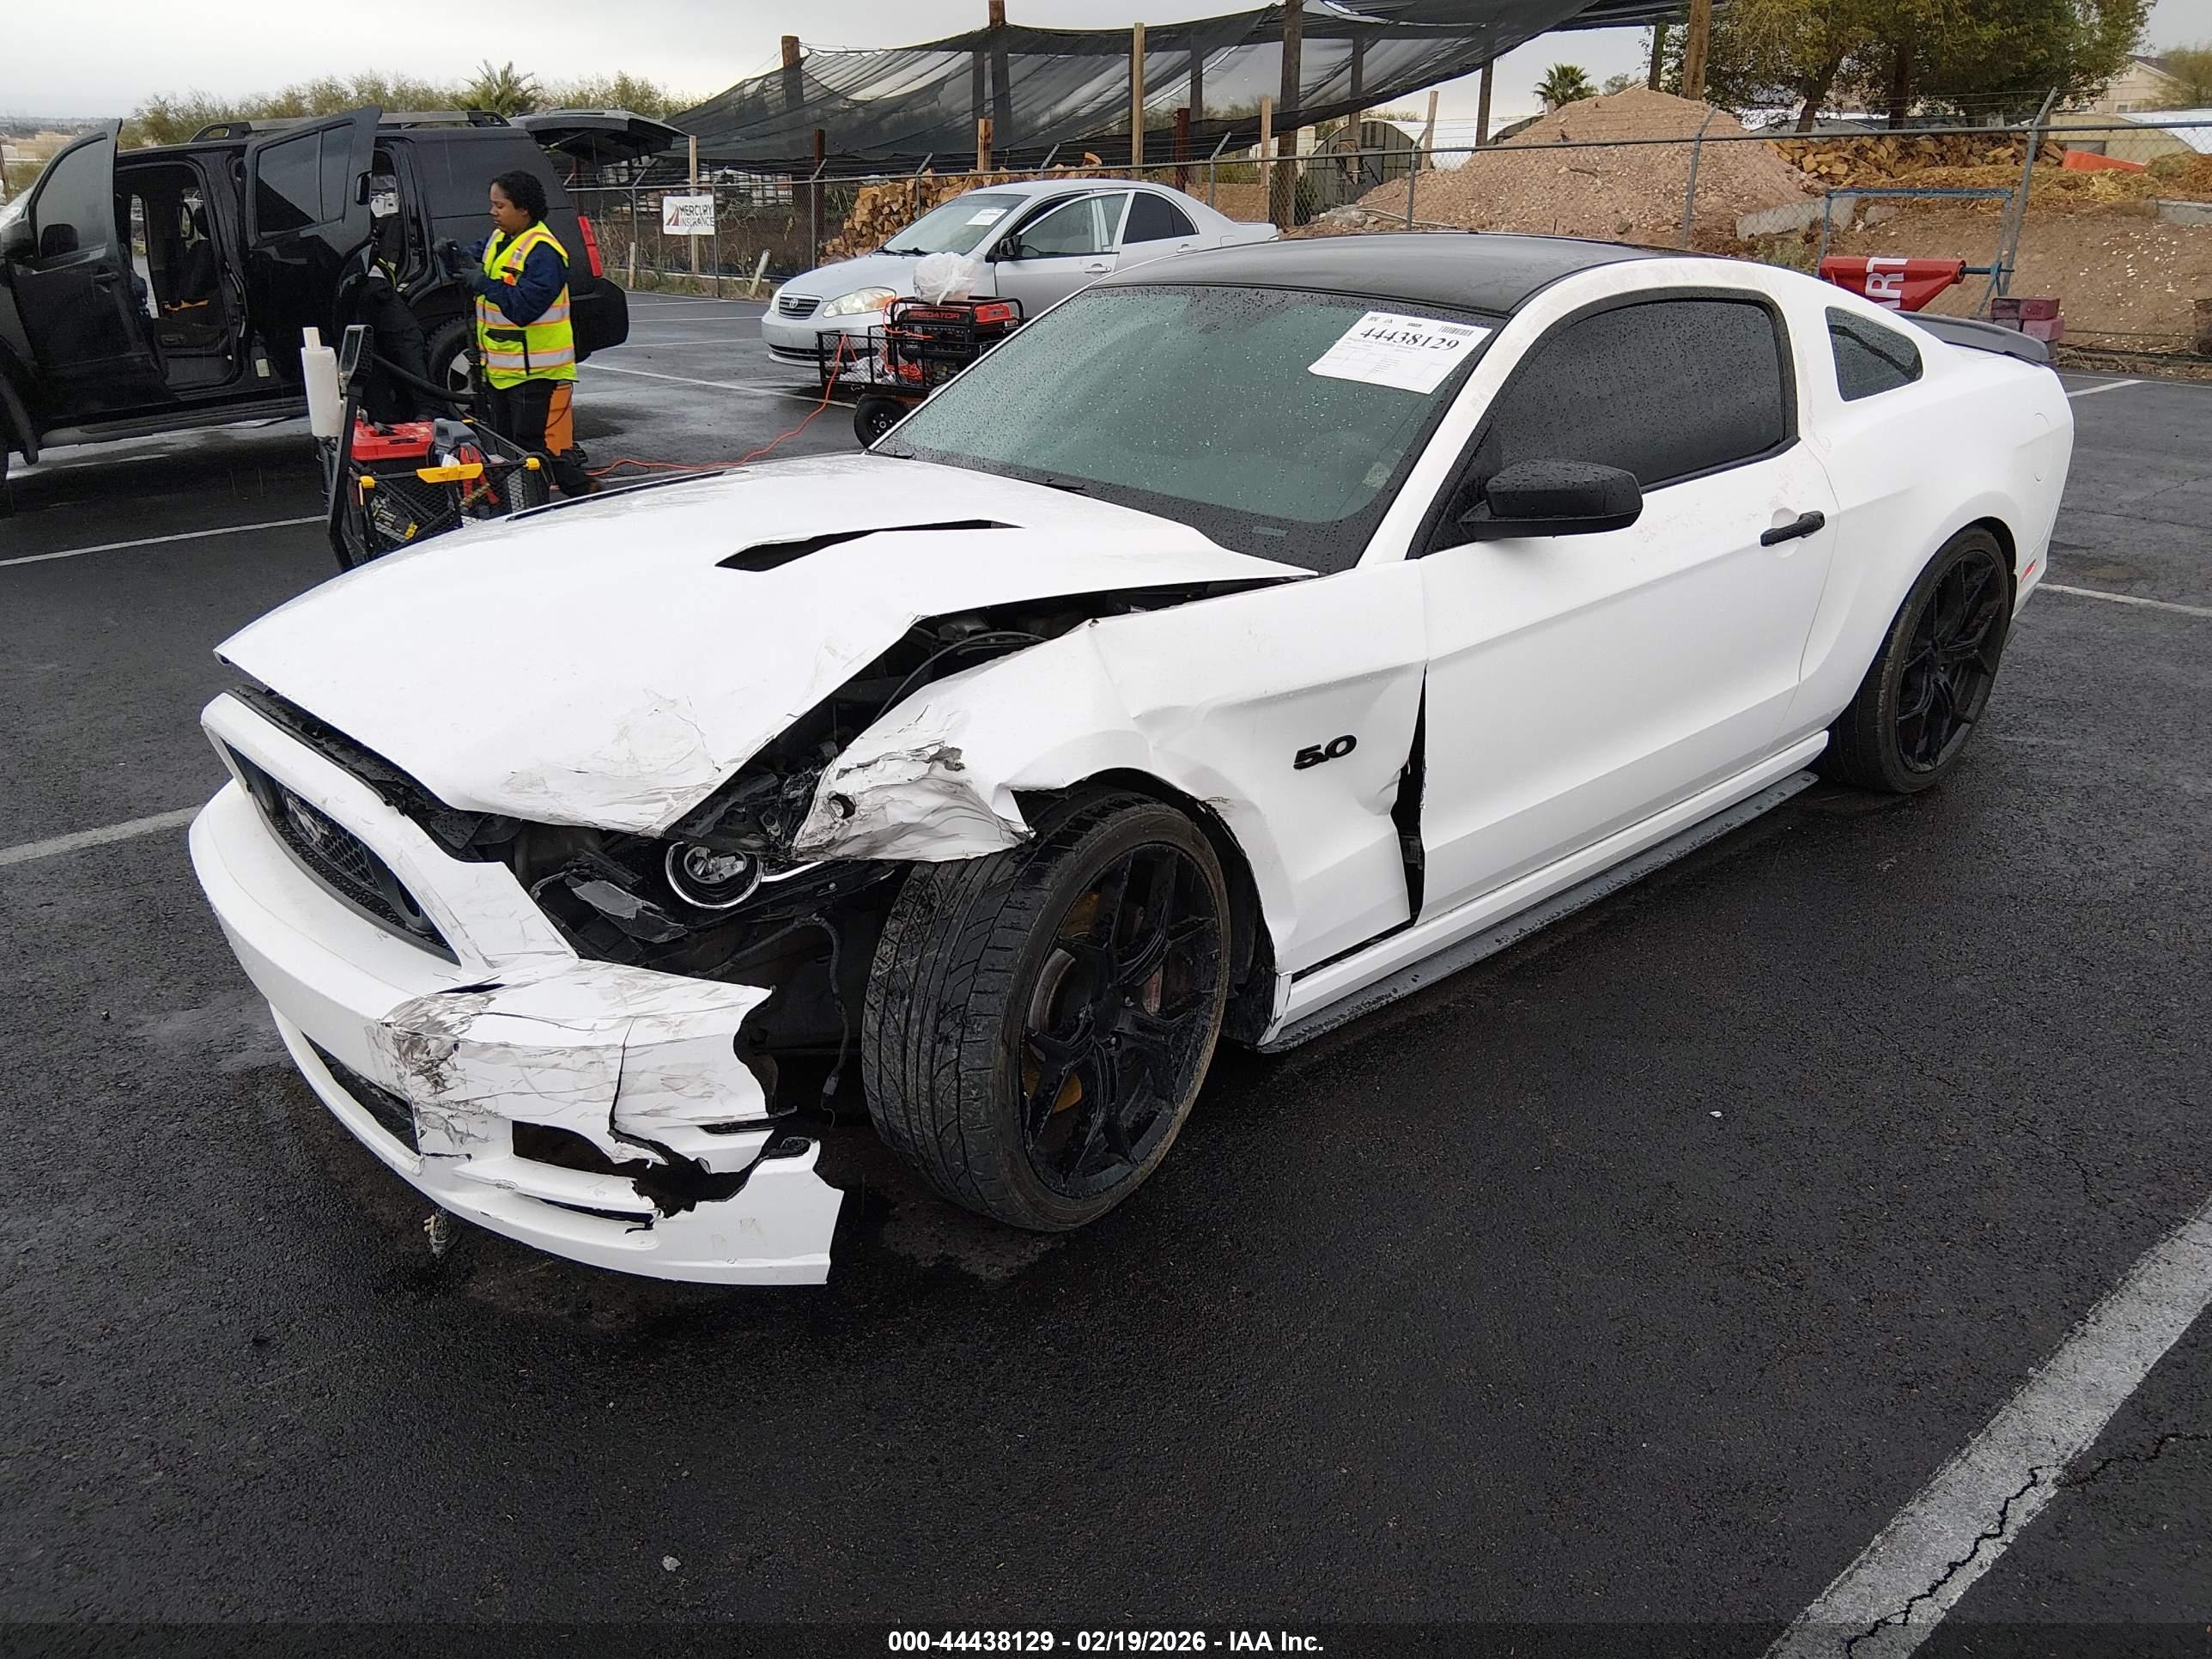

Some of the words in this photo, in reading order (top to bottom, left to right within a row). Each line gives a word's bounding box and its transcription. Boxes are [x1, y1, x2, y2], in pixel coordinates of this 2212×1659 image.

[679, 204, 713, 216] MERCURY
[908, 310, 959, 319] PREDATOR
[1360, 327, 1460, 351] 44438129
